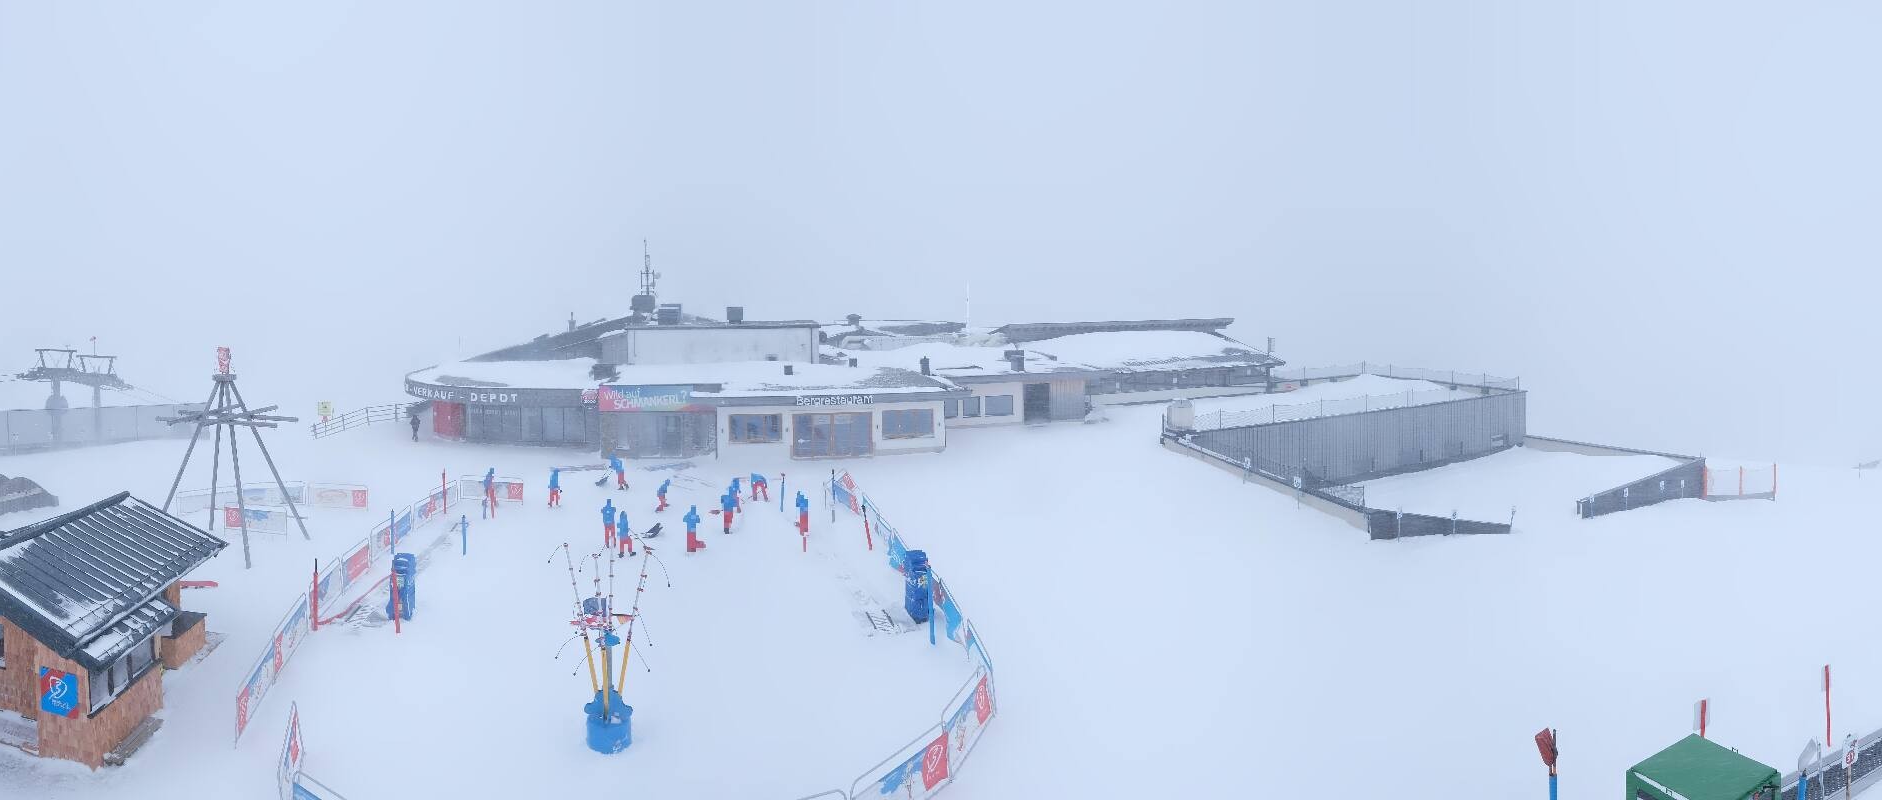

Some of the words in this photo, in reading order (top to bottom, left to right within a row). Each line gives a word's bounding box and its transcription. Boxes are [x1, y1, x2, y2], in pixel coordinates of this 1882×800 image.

[470, 392, 518, 403] DEPOT
[604, 389, 624, 400] Wild
[796, 394, 874, 406] Bergrestaurant
